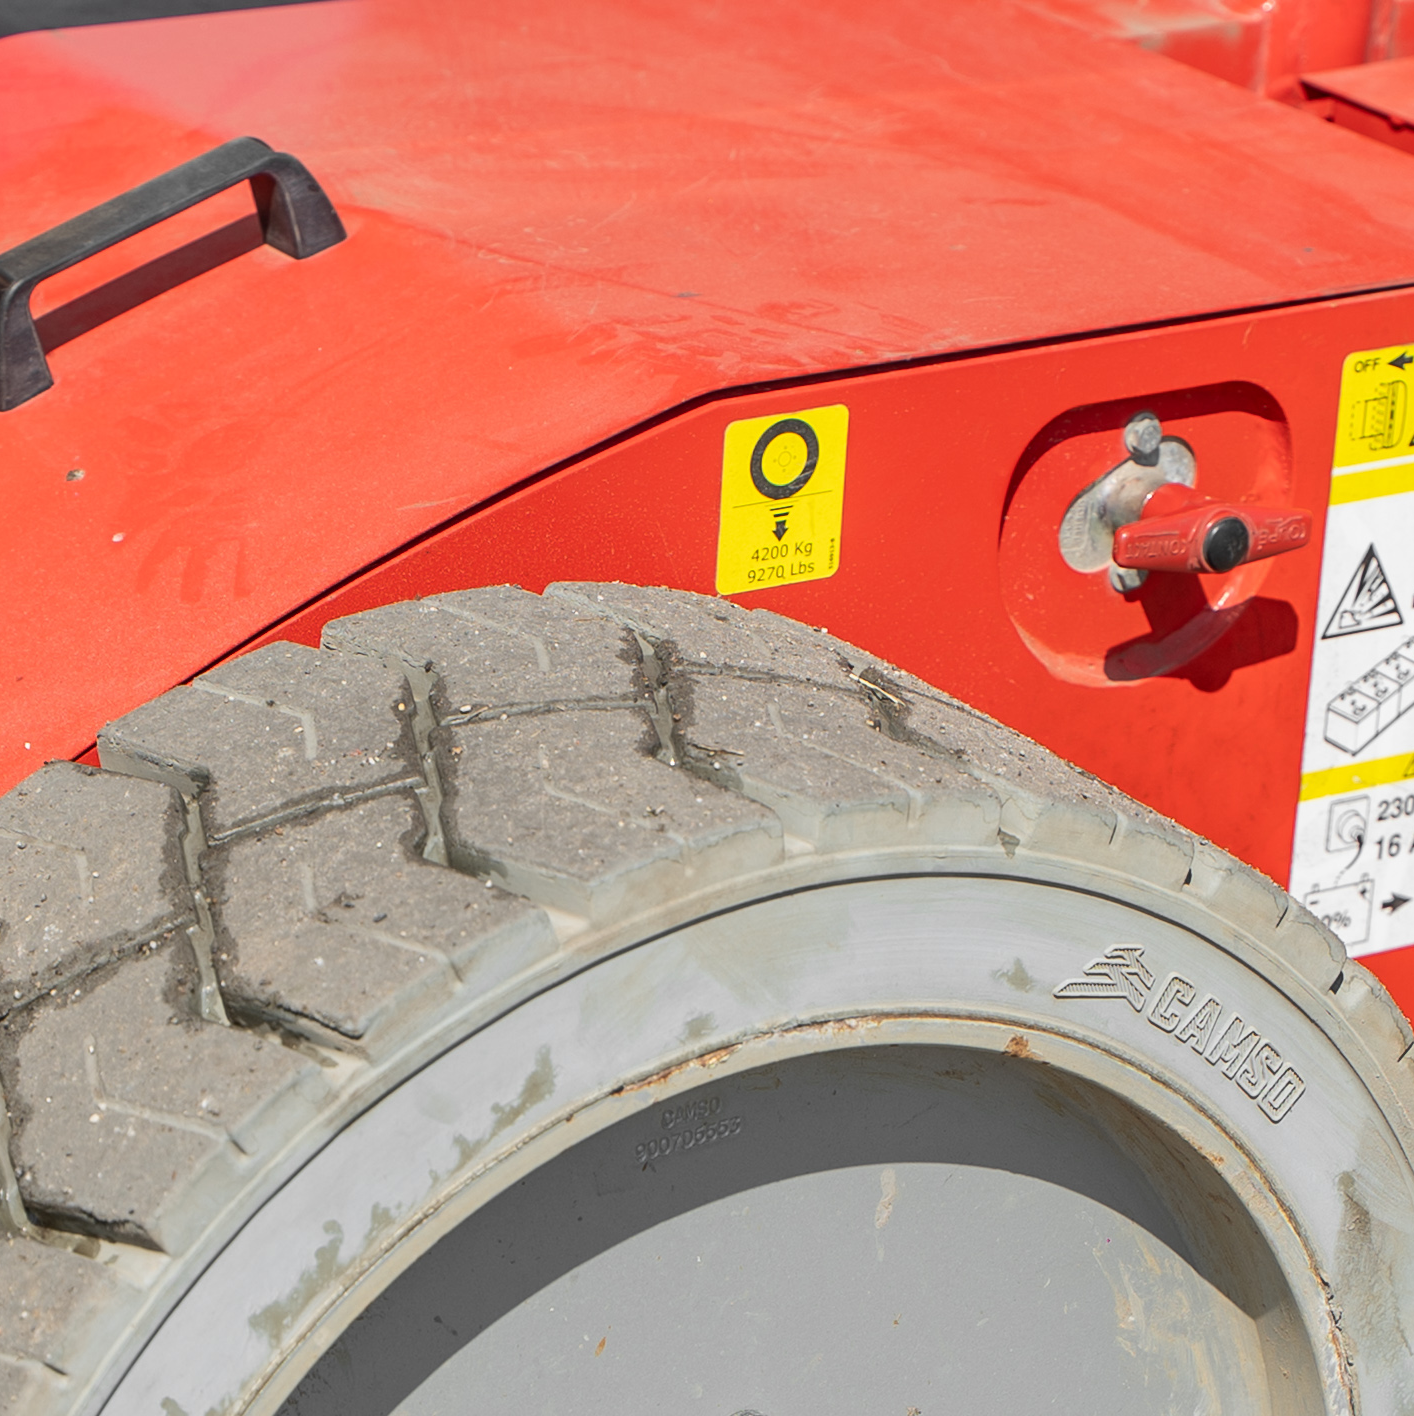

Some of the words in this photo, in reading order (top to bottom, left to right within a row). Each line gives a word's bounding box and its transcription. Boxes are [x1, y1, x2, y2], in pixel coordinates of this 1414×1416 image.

[1354, 357, 1381, 373] OFF
[751, 544, 789, 562] 4200
[794, 541, 813, 557] Kg
[747, 564, 785, 583] 9270
[791, 561, 815, 577] Lbs
[1376, 833, 1401, 860] 16
[1147, 971, 1307, 1125] CAMSO
